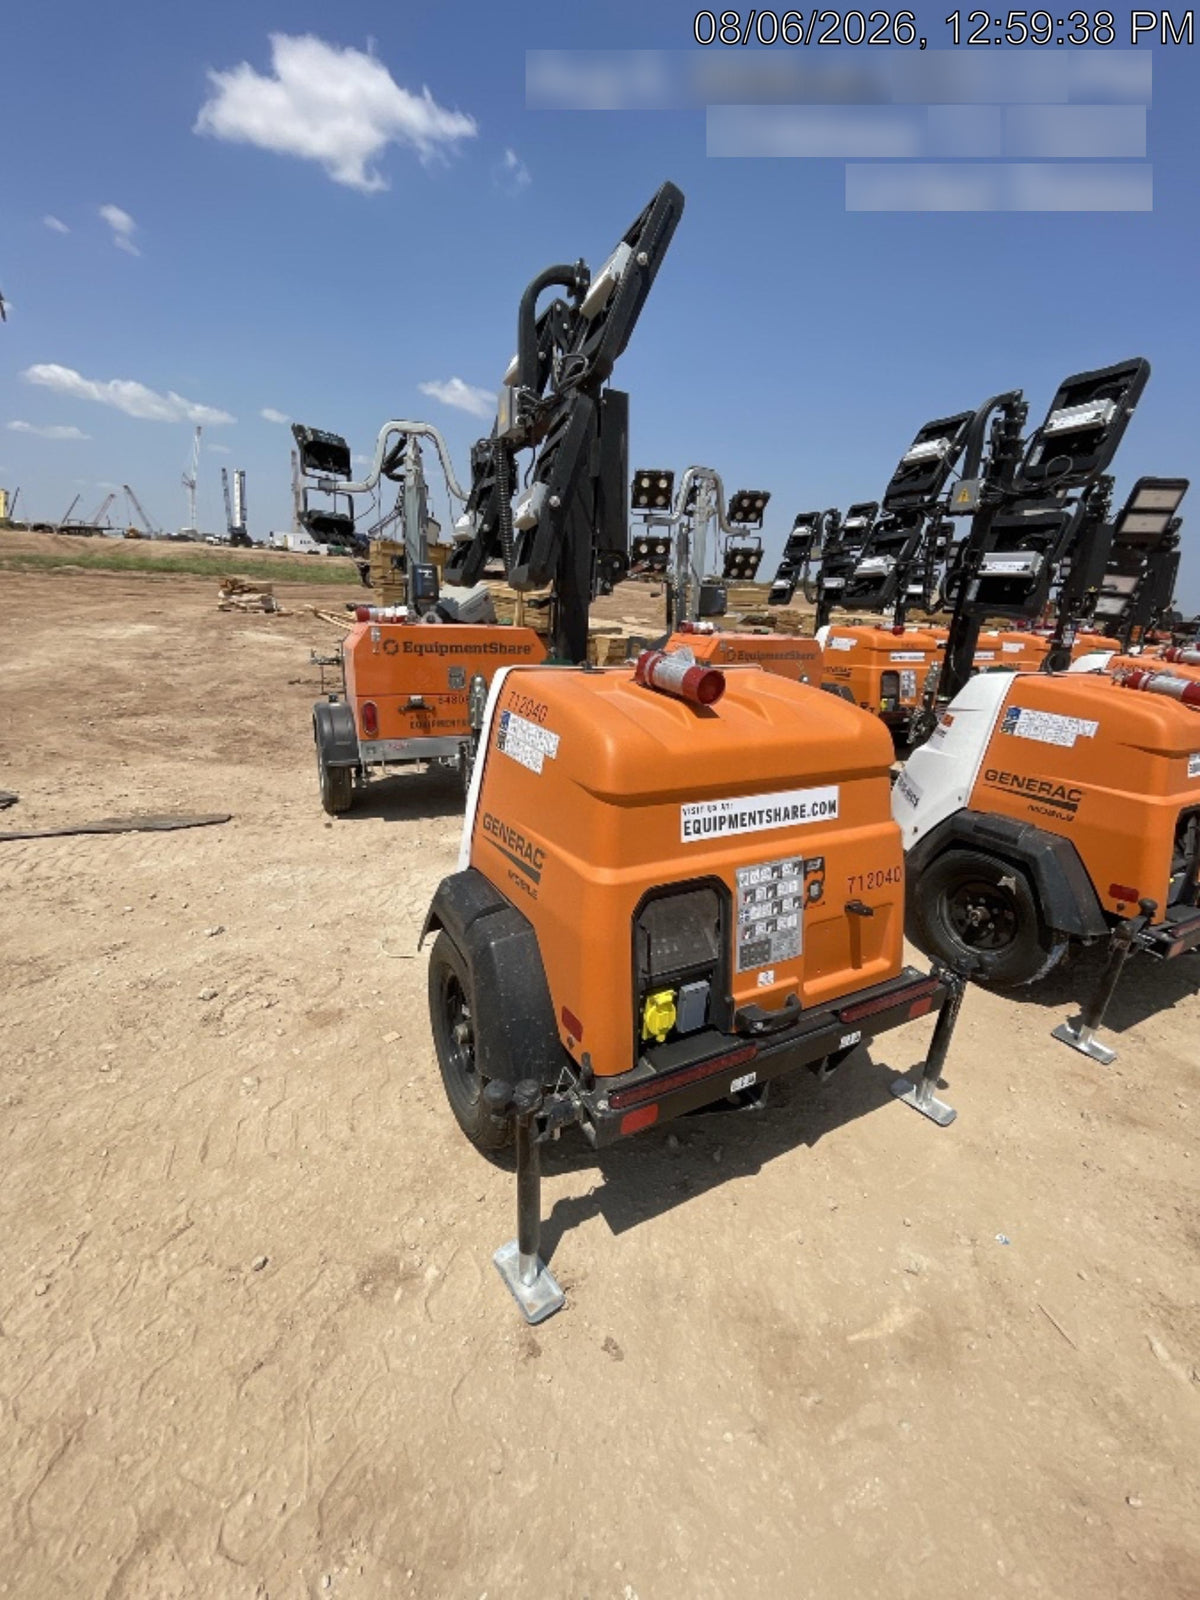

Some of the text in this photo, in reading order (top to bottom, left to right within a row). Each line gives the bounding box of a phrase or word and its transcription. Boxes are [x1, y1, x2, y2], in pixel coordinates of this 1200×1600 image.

[402, 641, 534, 656] EquipmentShare
[982, 769, 1083, 803] GENERAC
[683, 799, 837, 836] EQUIPMENTSHARE.COM
[483, 812, 546, 870] GENERAC
